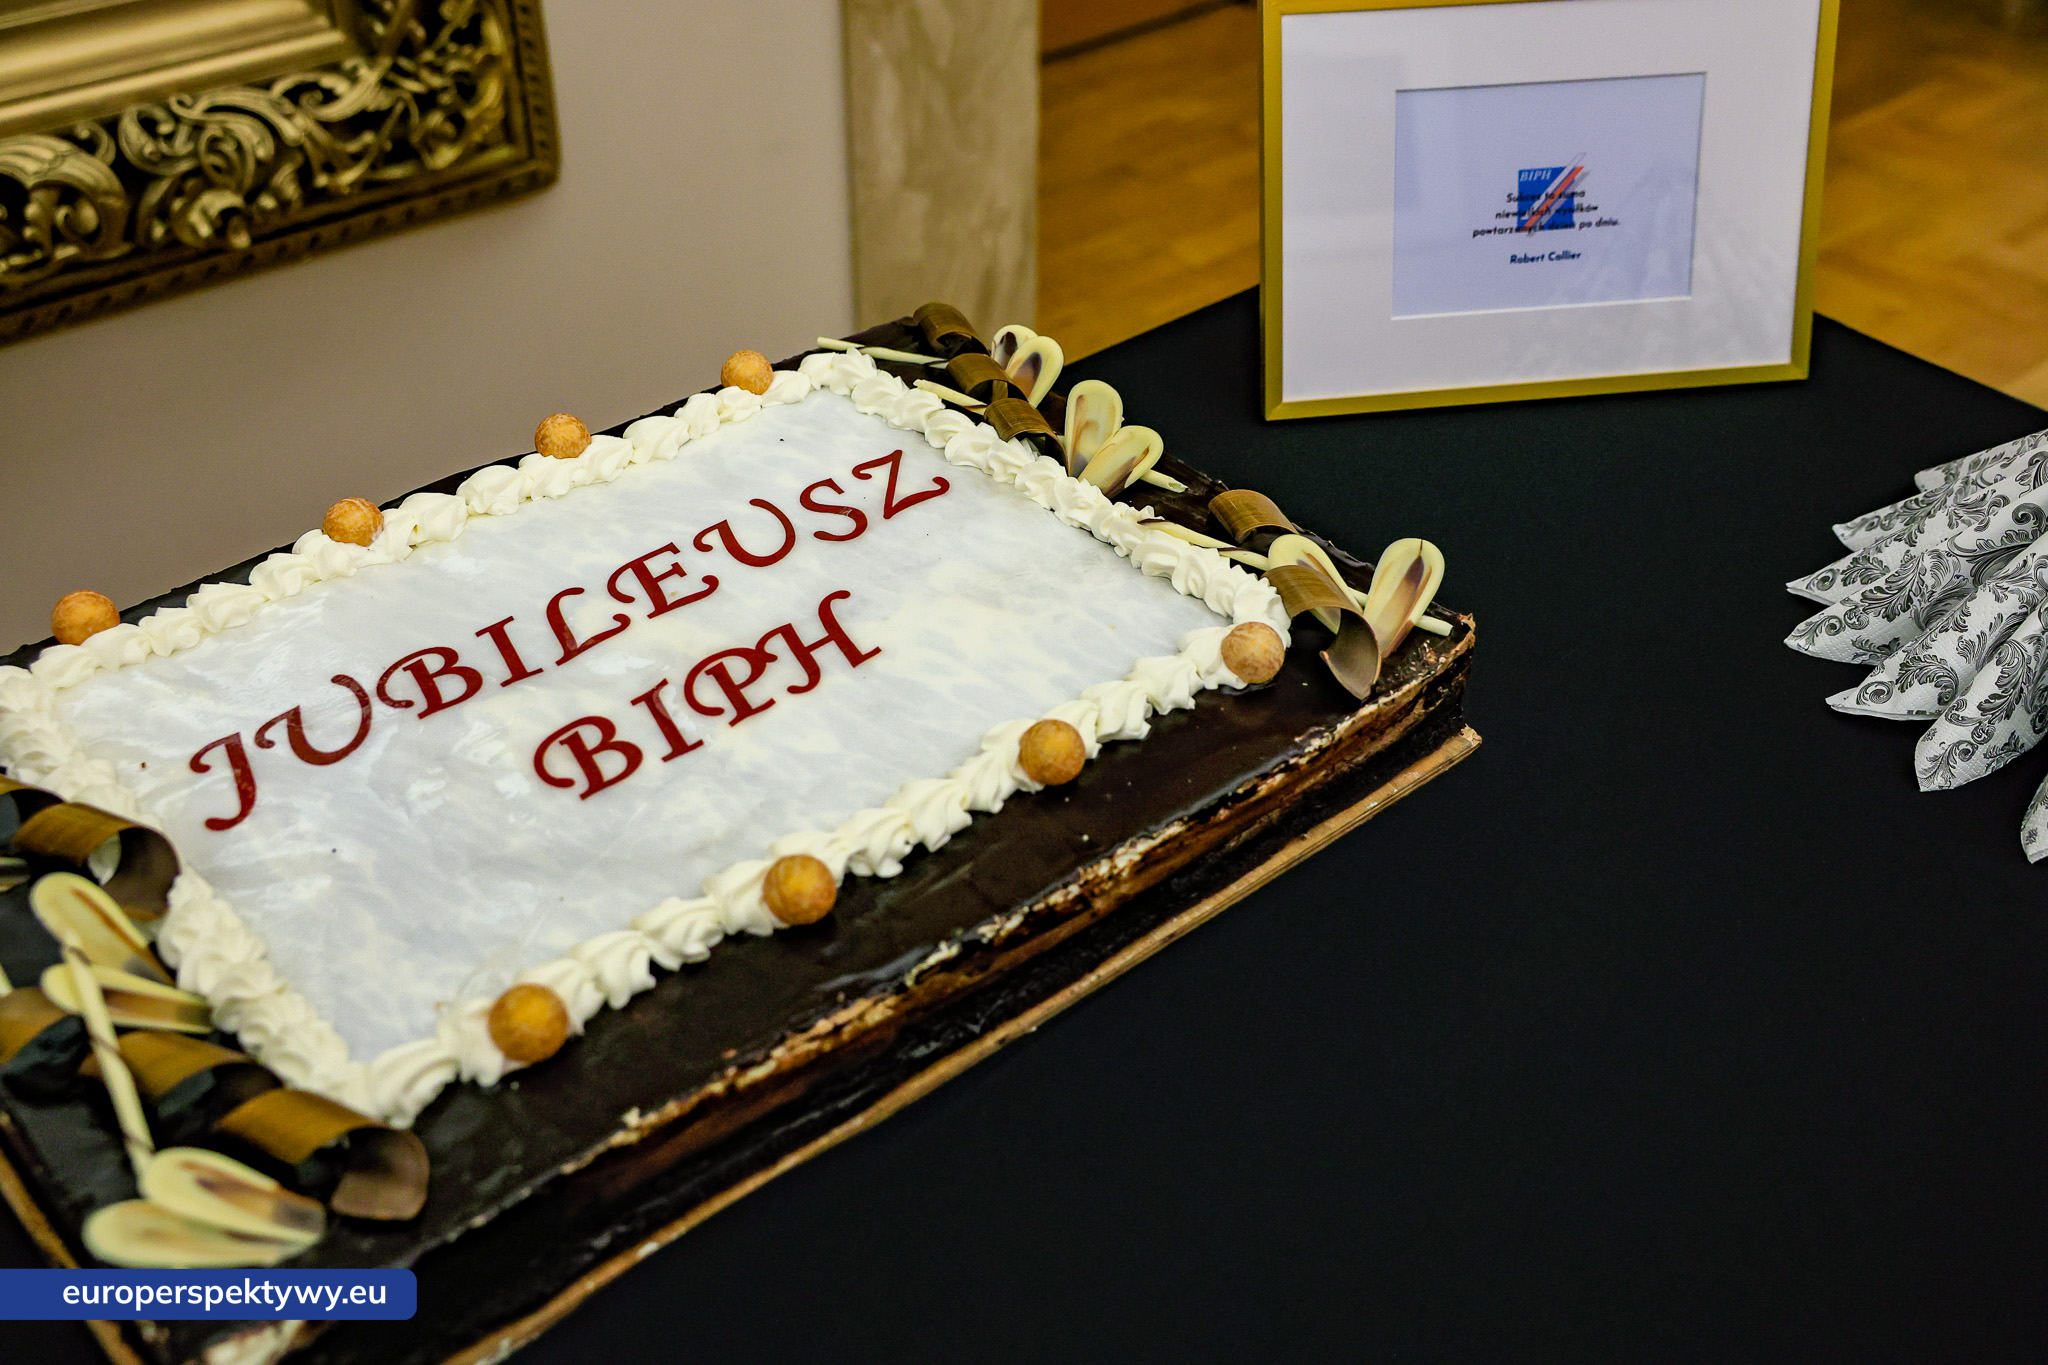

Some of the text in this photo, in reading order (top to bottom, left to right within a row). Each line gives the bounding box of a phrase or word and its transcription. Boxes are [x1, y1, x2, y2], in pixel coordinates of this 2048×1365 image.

[1519, 169, 1552, 182] BIPH
[1578, 221, 1592, 231] po
[1510, 250, 1582, 264] Robert Collier
[189, 449, 950, 832] JUBILEUSZ
[533, 590, 883, 801] BIPH
